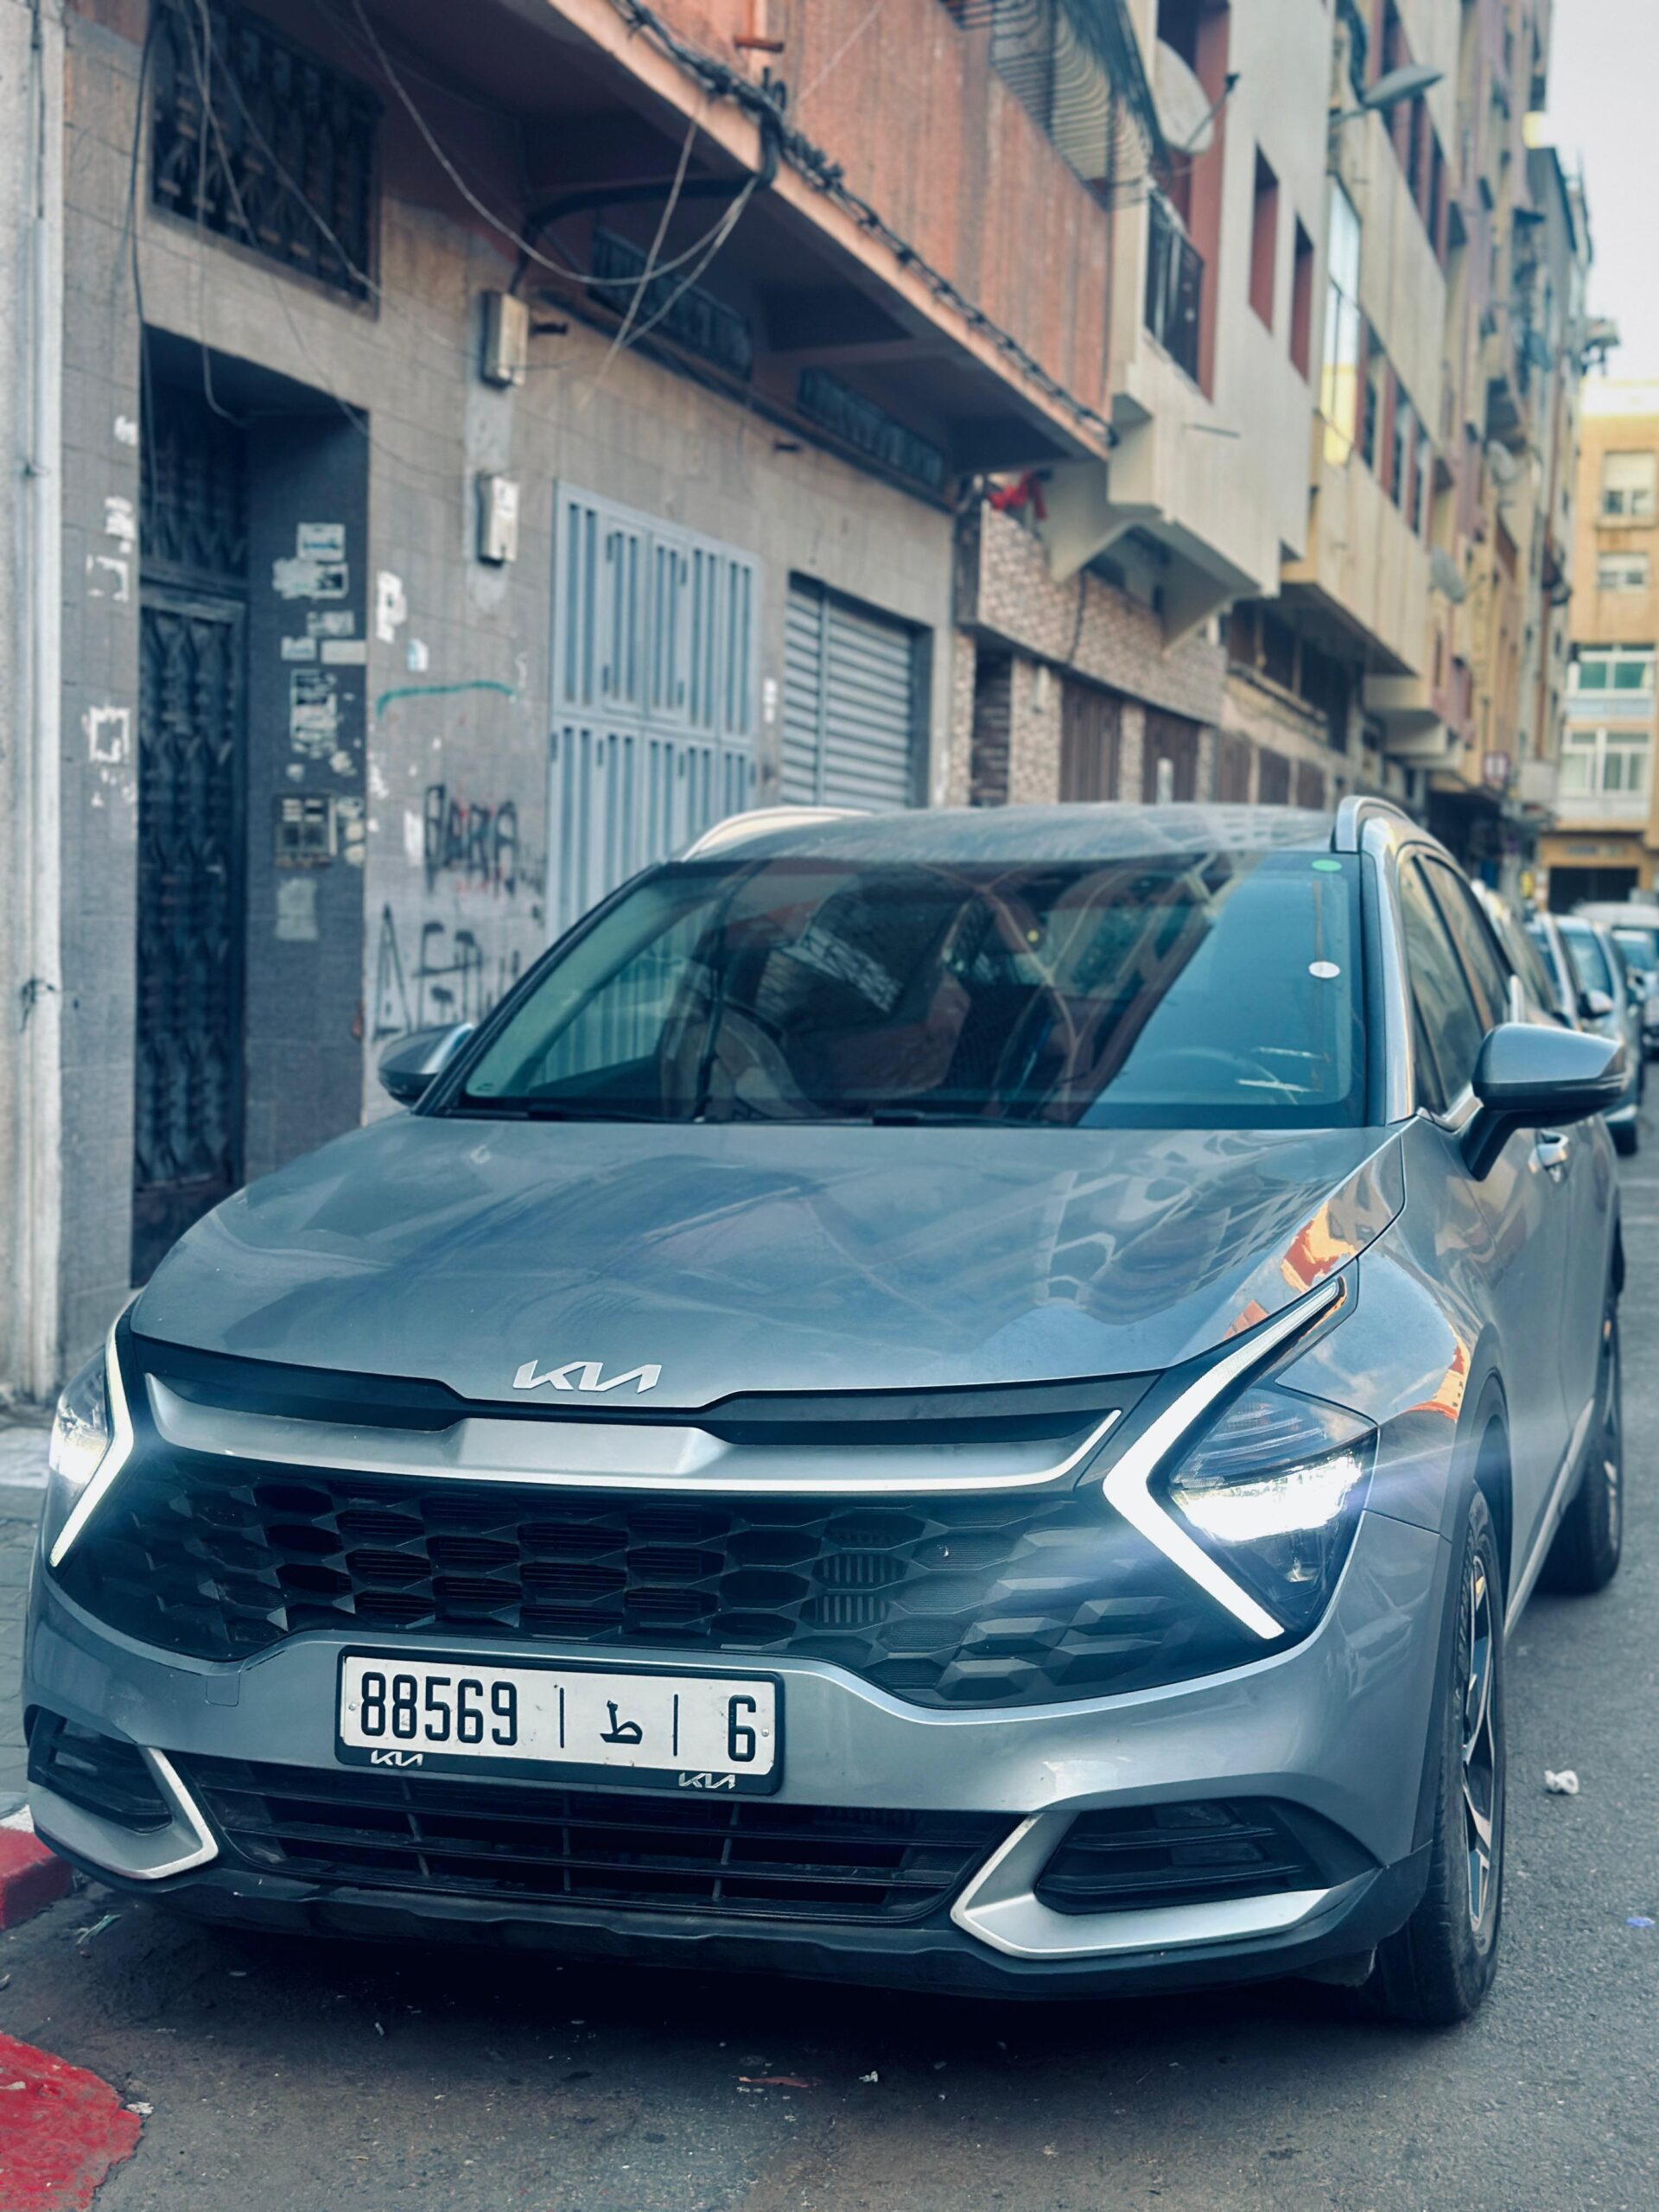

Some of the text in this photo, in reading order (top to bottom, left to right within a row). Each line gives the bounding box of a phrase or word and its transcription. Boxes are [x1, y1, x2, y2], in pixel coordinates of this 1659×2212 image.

[512, 1359, 663, 1394] KIA
[361, 1671, 756, 1762] 88569 ط 6
[371, 1749, 423, 1767] KIA
[678, 1772, 735, 1789] KIA
